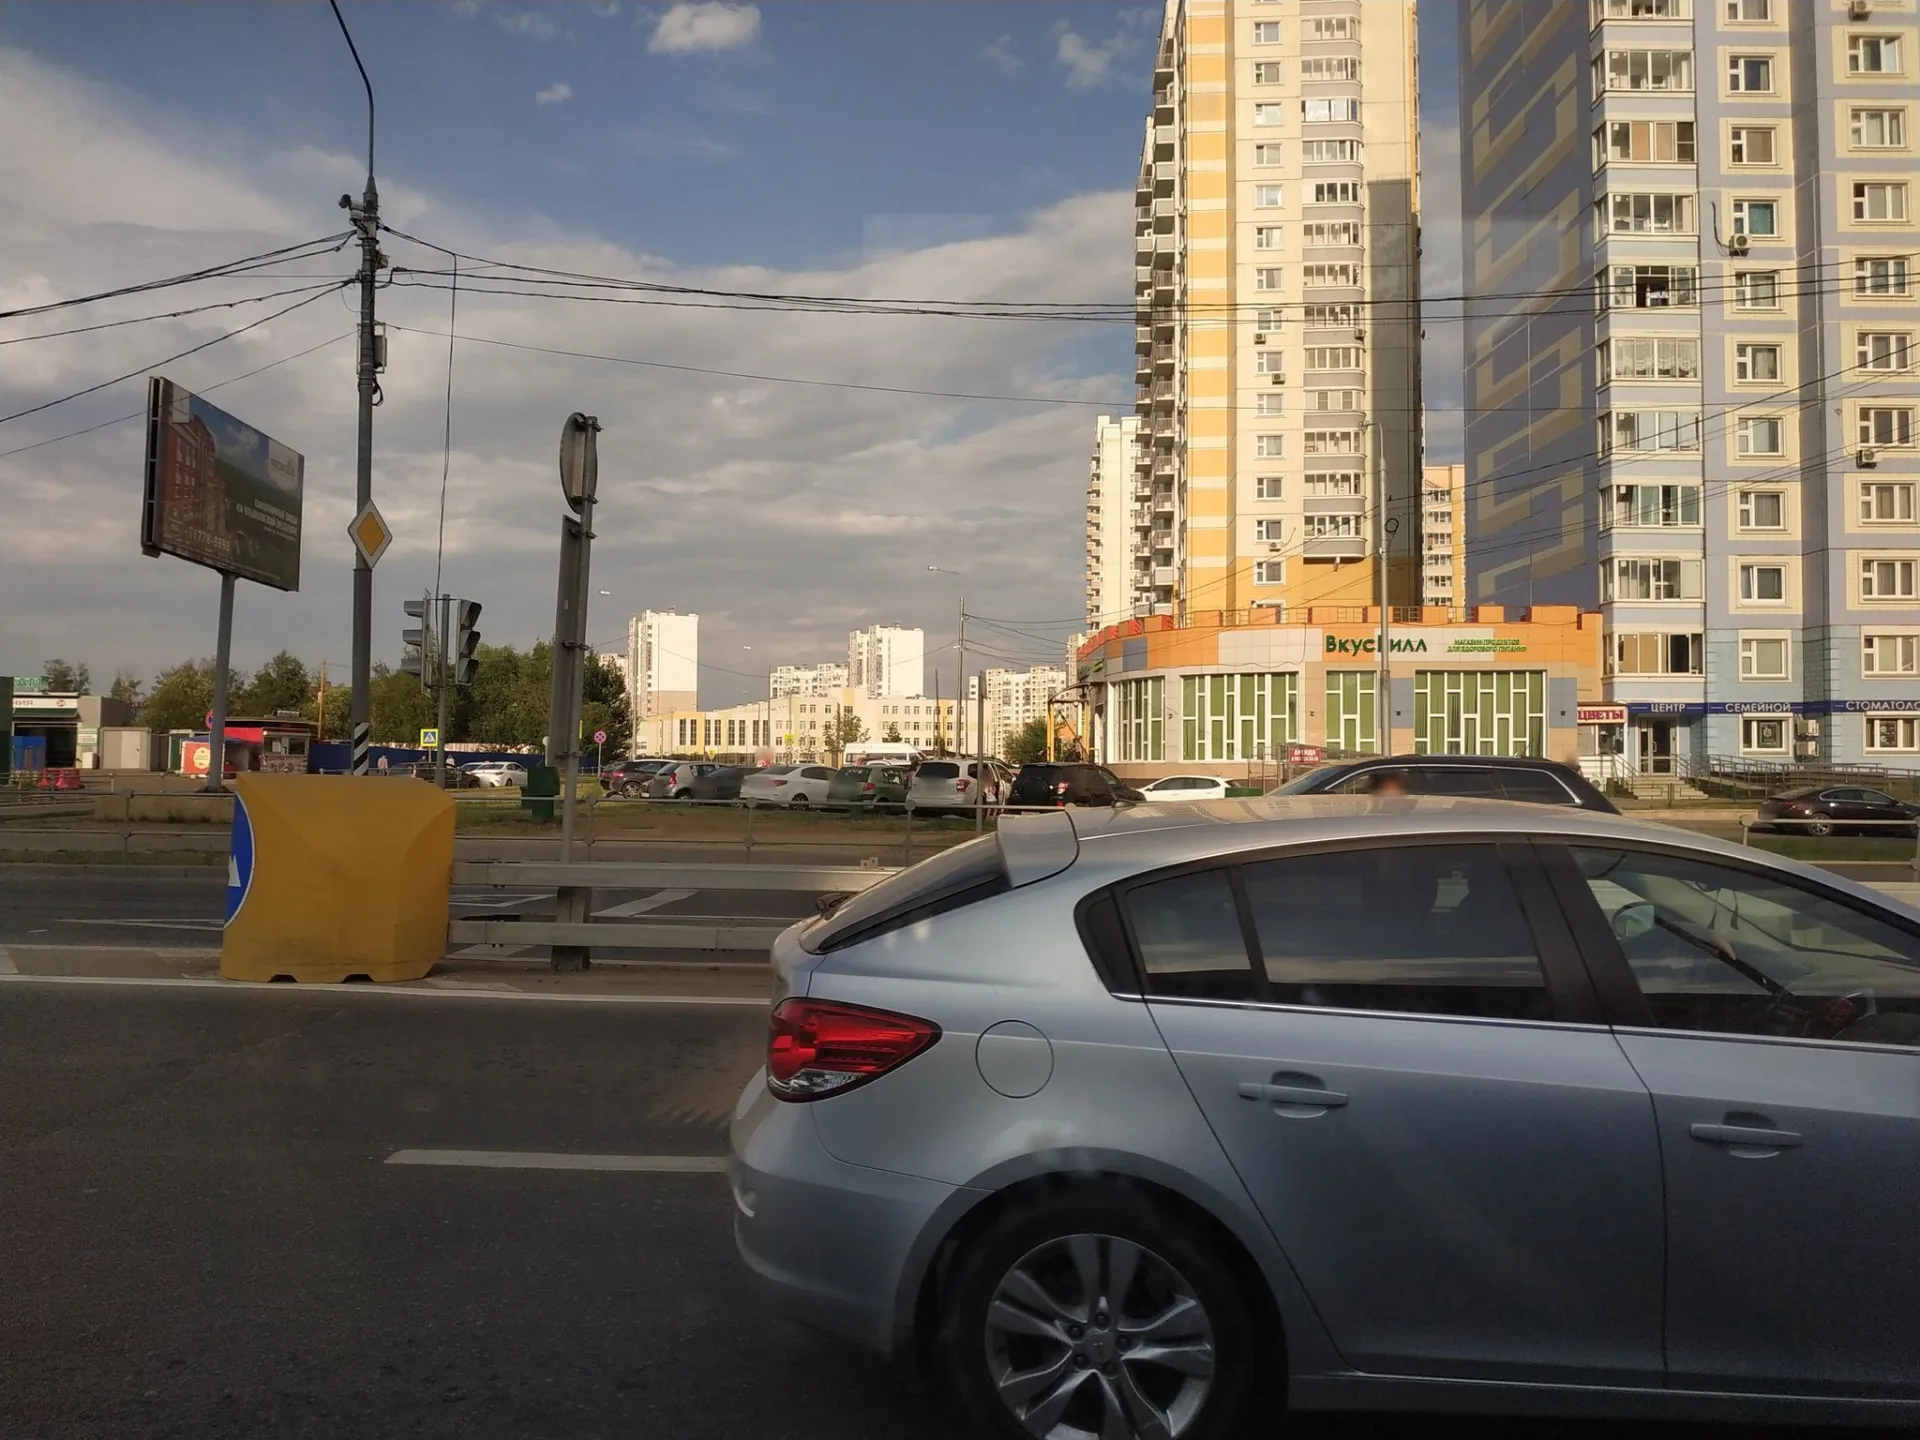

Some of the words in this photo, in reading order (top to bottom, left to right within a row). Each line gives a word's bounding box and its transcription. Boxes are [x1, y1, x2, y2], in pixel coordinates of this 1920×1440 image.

[1650, 703, 1687, 713] ЦЕНТР
[1725, 702, 1791, 712] СЕМЕЙНОЙ
[1845, 700, 1920, 711] СТОМАТОЛО
[1577, 710, 1624, 721] ЦВЕТЫ
